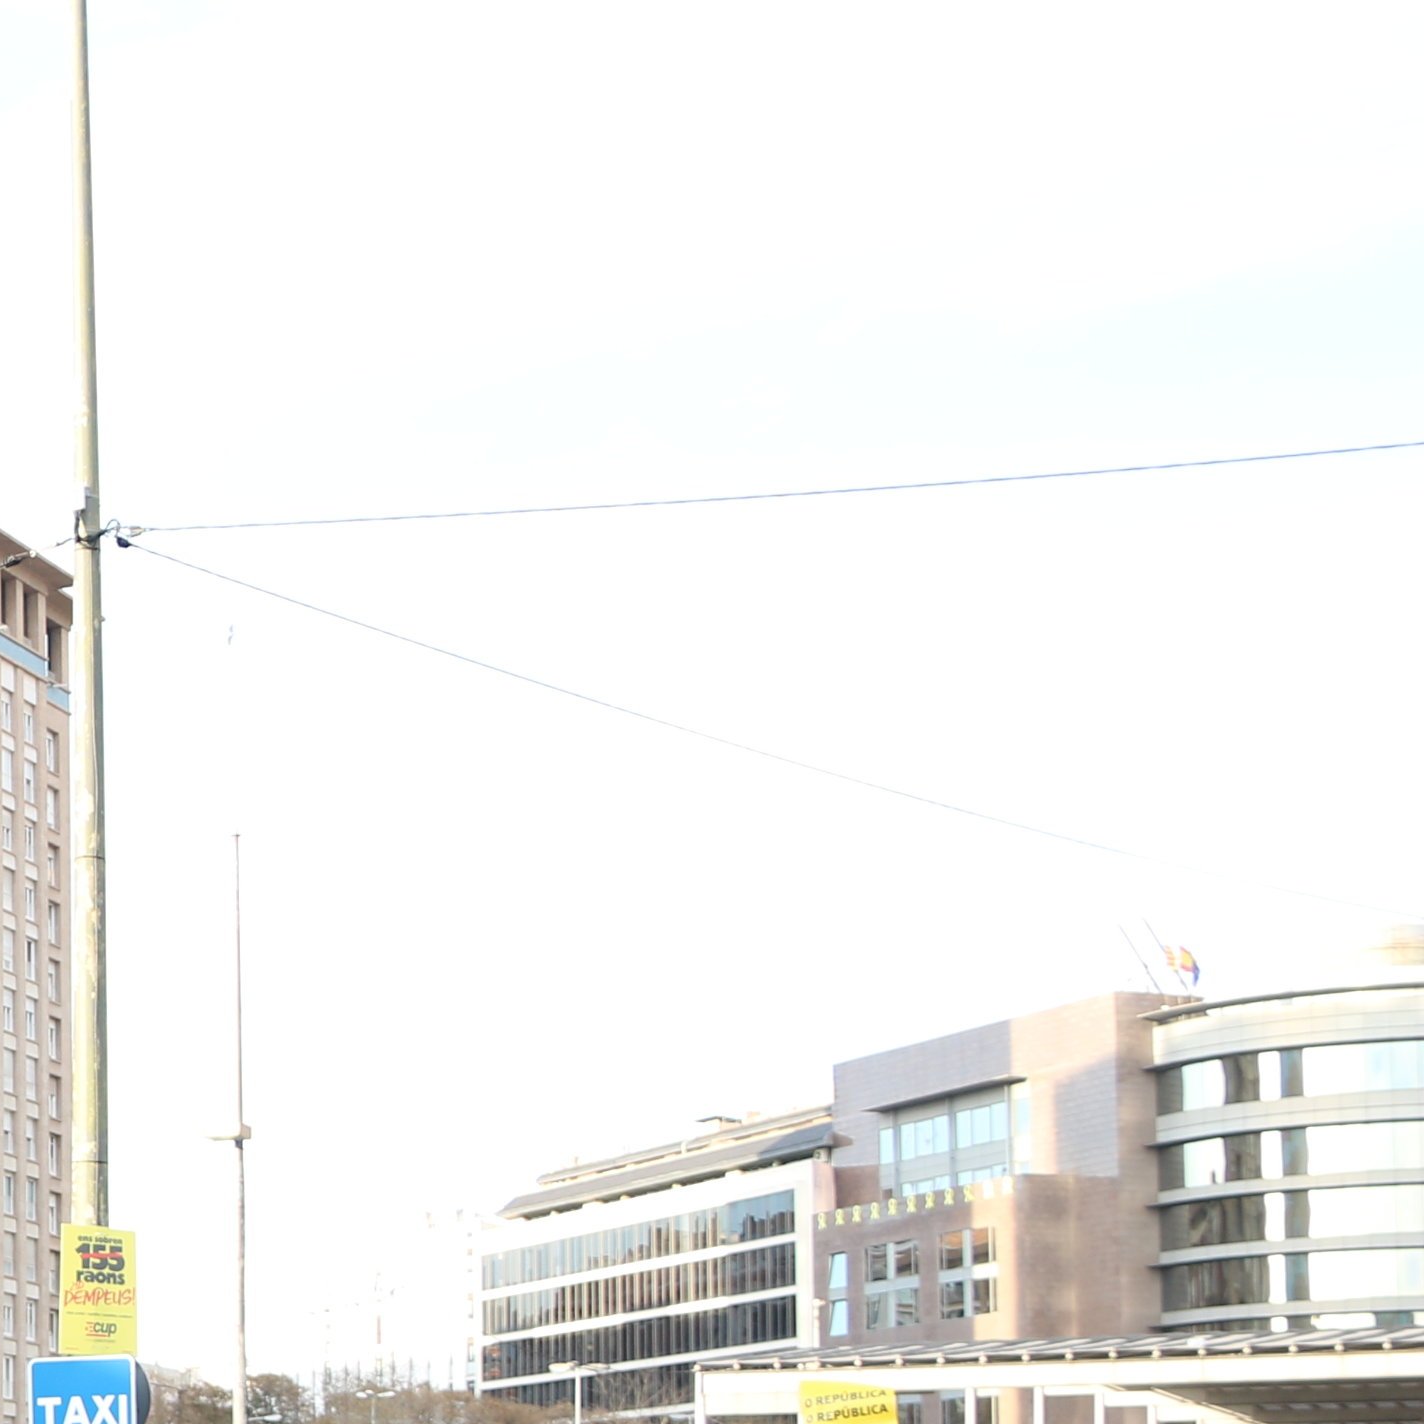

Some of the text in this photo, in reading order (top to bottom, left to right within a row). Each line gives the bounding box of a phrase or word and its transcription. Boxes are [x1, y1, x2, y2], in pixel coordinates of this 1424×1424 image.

[75, 1243, 125, 1271] 155
[76, 1270, 125, 1285] raons
[817, 1403, 889, 1422] REPÚBLICA
